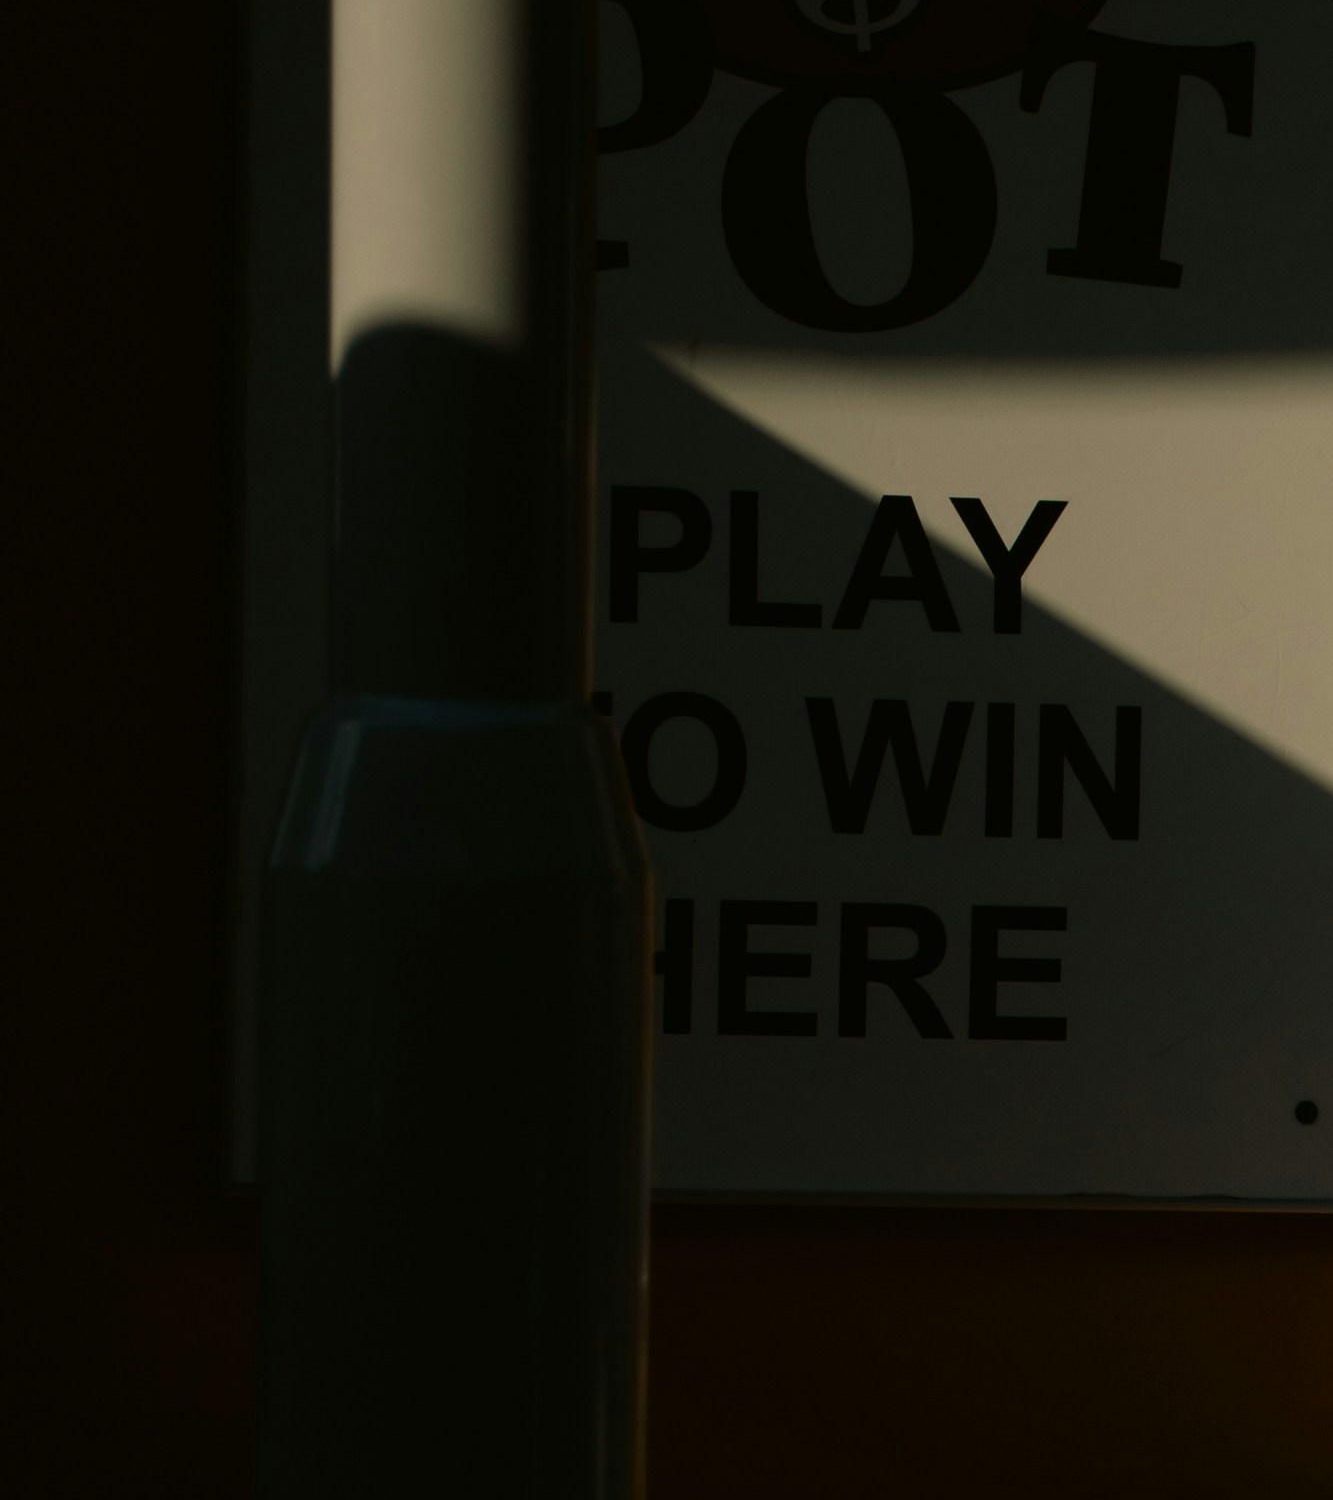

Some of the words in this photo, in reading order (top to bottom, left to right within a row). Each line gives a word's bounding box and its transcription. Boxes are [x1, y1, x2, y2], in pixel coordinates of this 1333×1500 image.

[608, 485, 1069, 635] PLAY
[592, 691, 748, 832] O
[805, 696, 1143, 841] WIN
